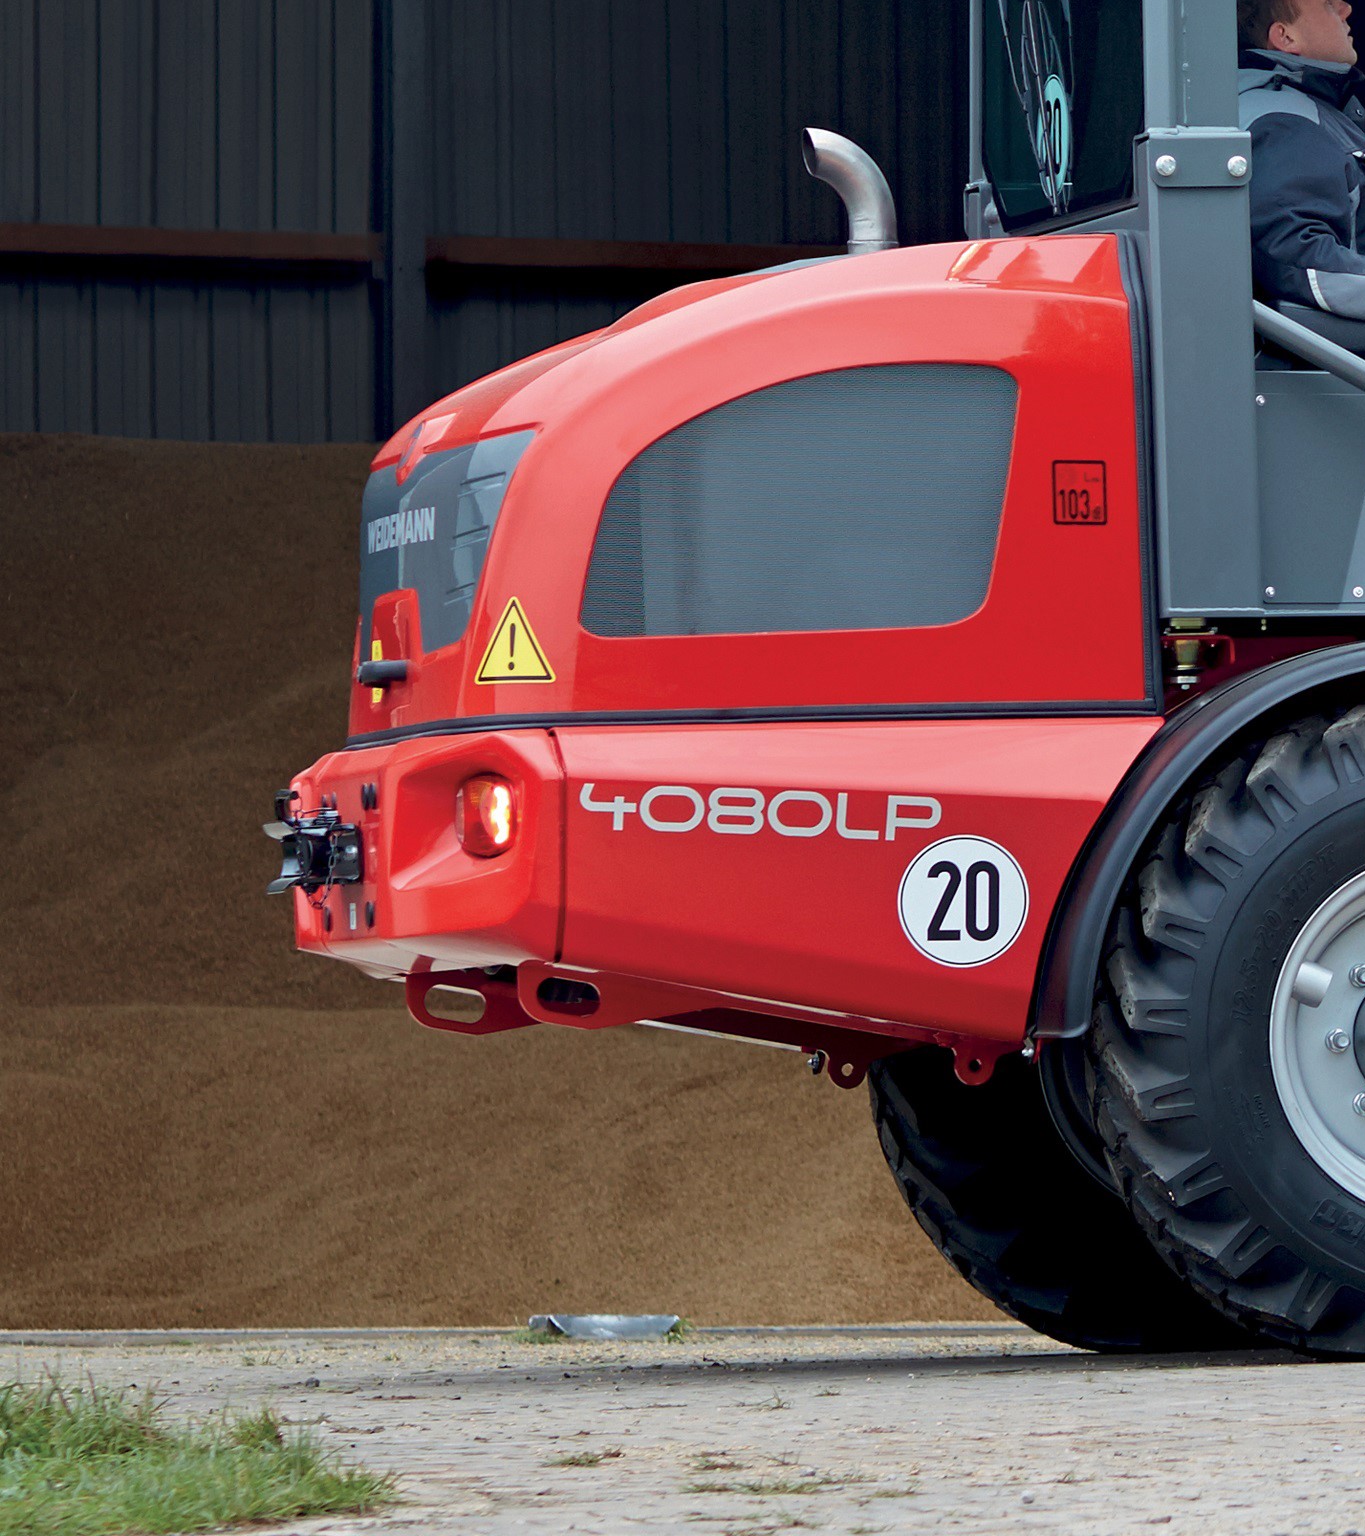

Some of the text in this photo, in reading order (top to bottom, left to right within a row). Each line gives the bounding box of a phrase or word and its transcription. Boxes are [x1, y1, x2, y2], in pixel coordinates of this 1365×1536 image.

[367, 506, 435, 554] WEIDEMANN
[1058, 489, 1090, 519] 103
[580, 784, 942, 842] 4080LP
[925, 860, 1000, 942] 20
